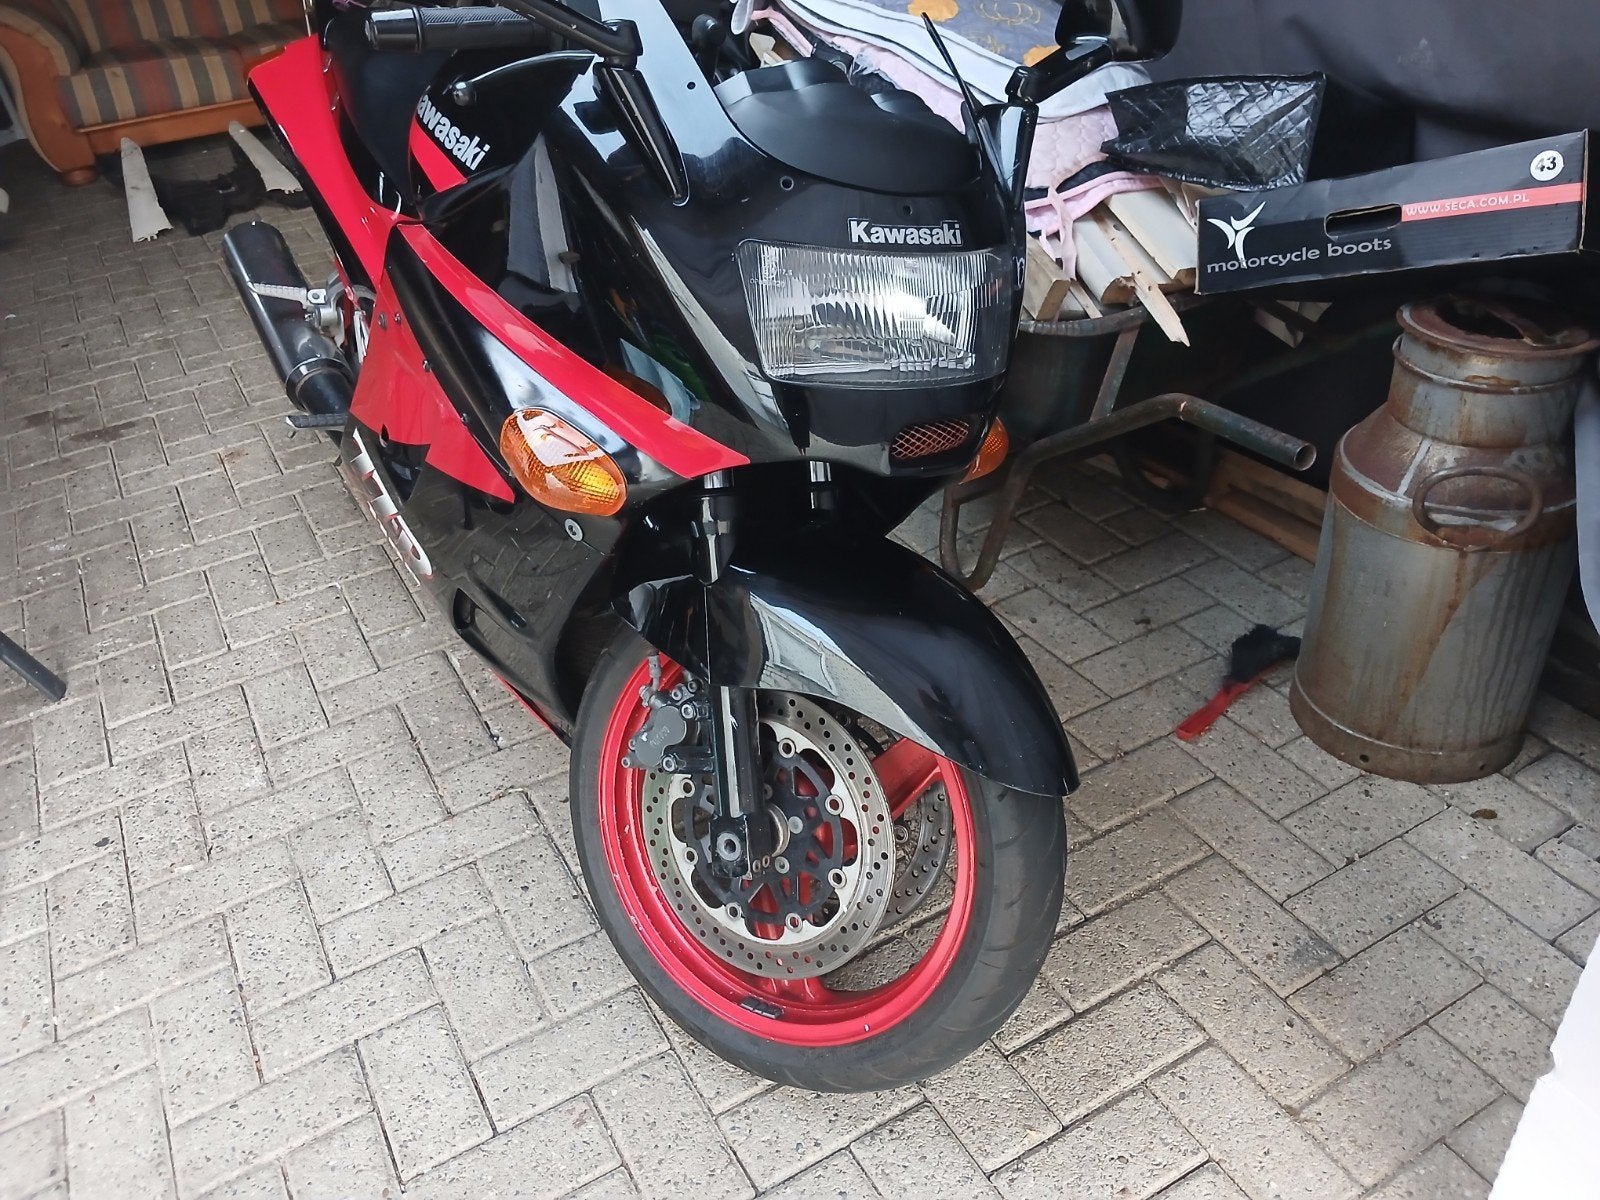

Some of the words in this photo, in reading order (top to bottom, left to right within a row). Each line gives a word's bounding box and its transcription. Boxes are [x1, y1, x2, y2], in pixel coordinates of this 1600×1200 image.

[417, 95, 490, 170] awasaki
[1535, 156, 1556, 172] 43
[1406, 193, 1530, 216] WWW.SECA.COM.PL
[850, 220, 962, 245] Kawasaki
[1207, 247, 1320, 273] motorcycle
[1327, 238, 1392, 257] boots
